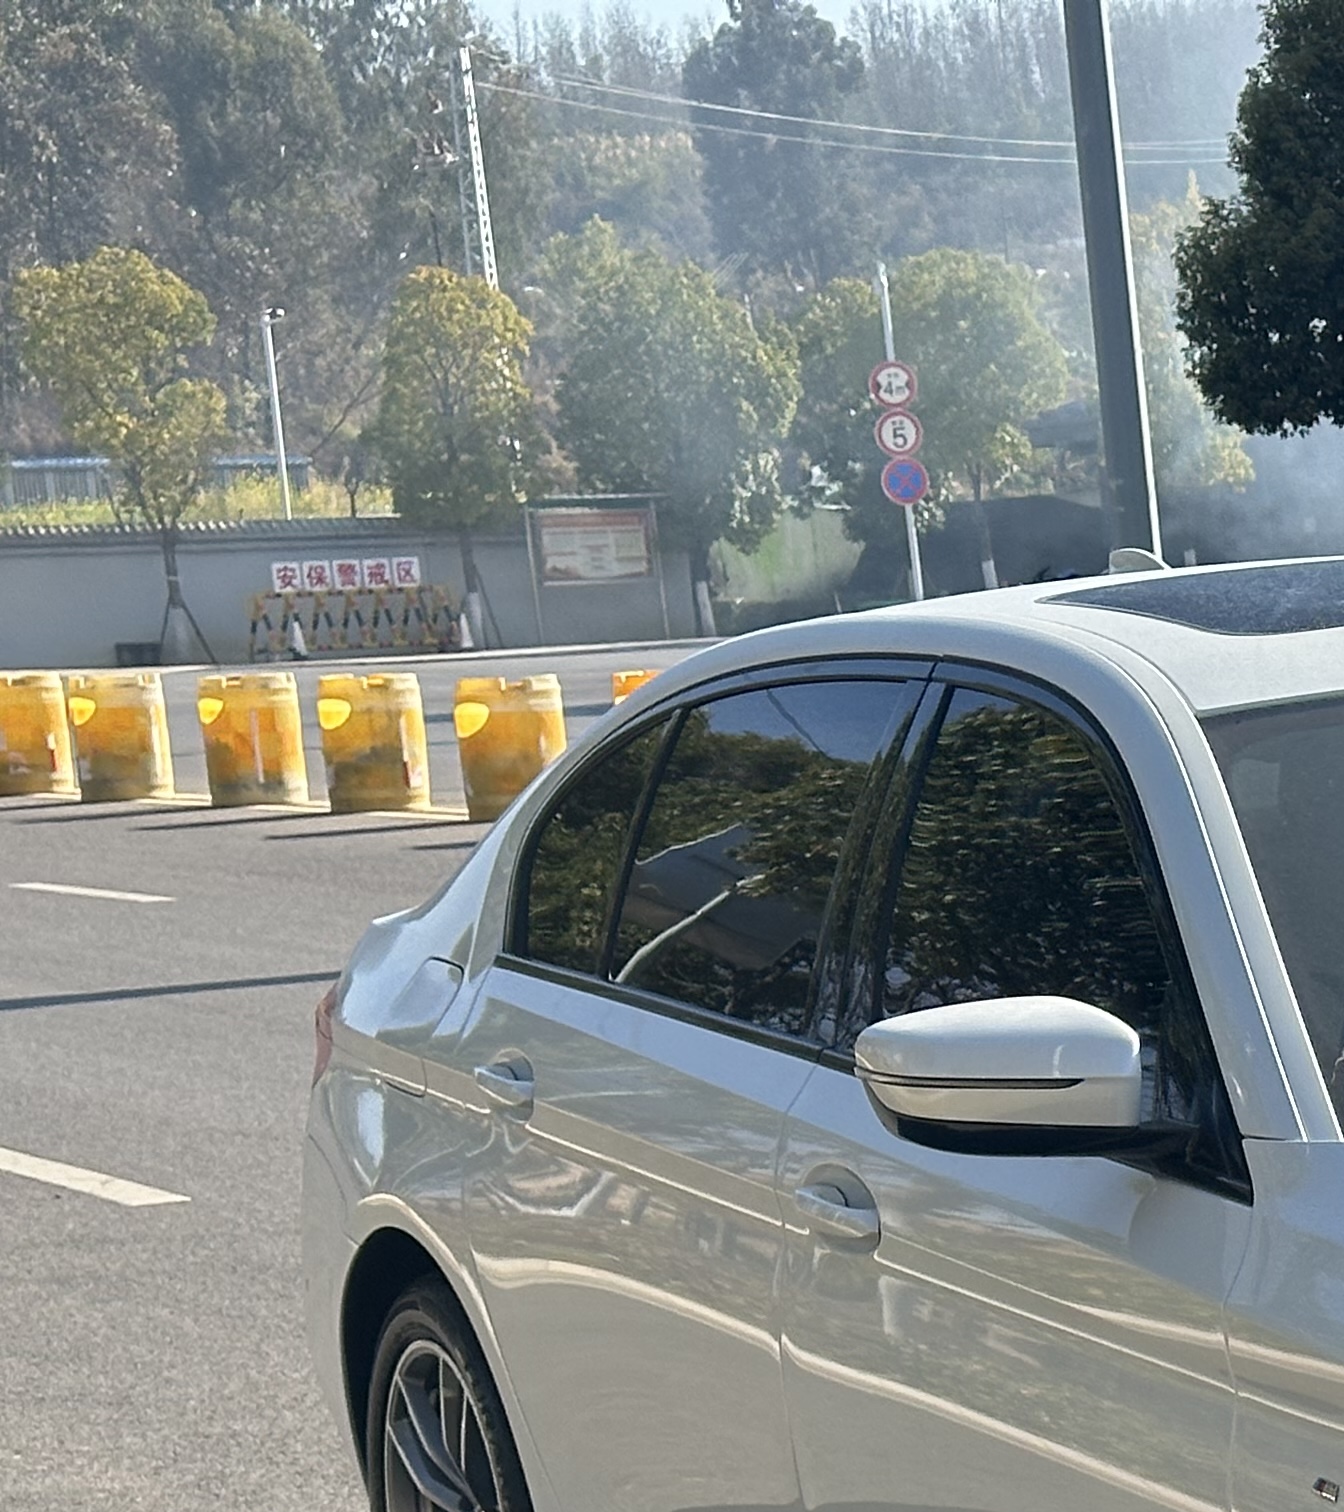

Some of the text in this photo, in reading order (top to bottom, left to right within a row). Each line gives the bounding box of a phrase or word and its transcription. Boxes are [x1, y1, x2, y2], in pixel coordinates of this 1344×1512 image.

[893, 427, 907, 449] 5
[276, 560, 417, 589] 安保警戒区
